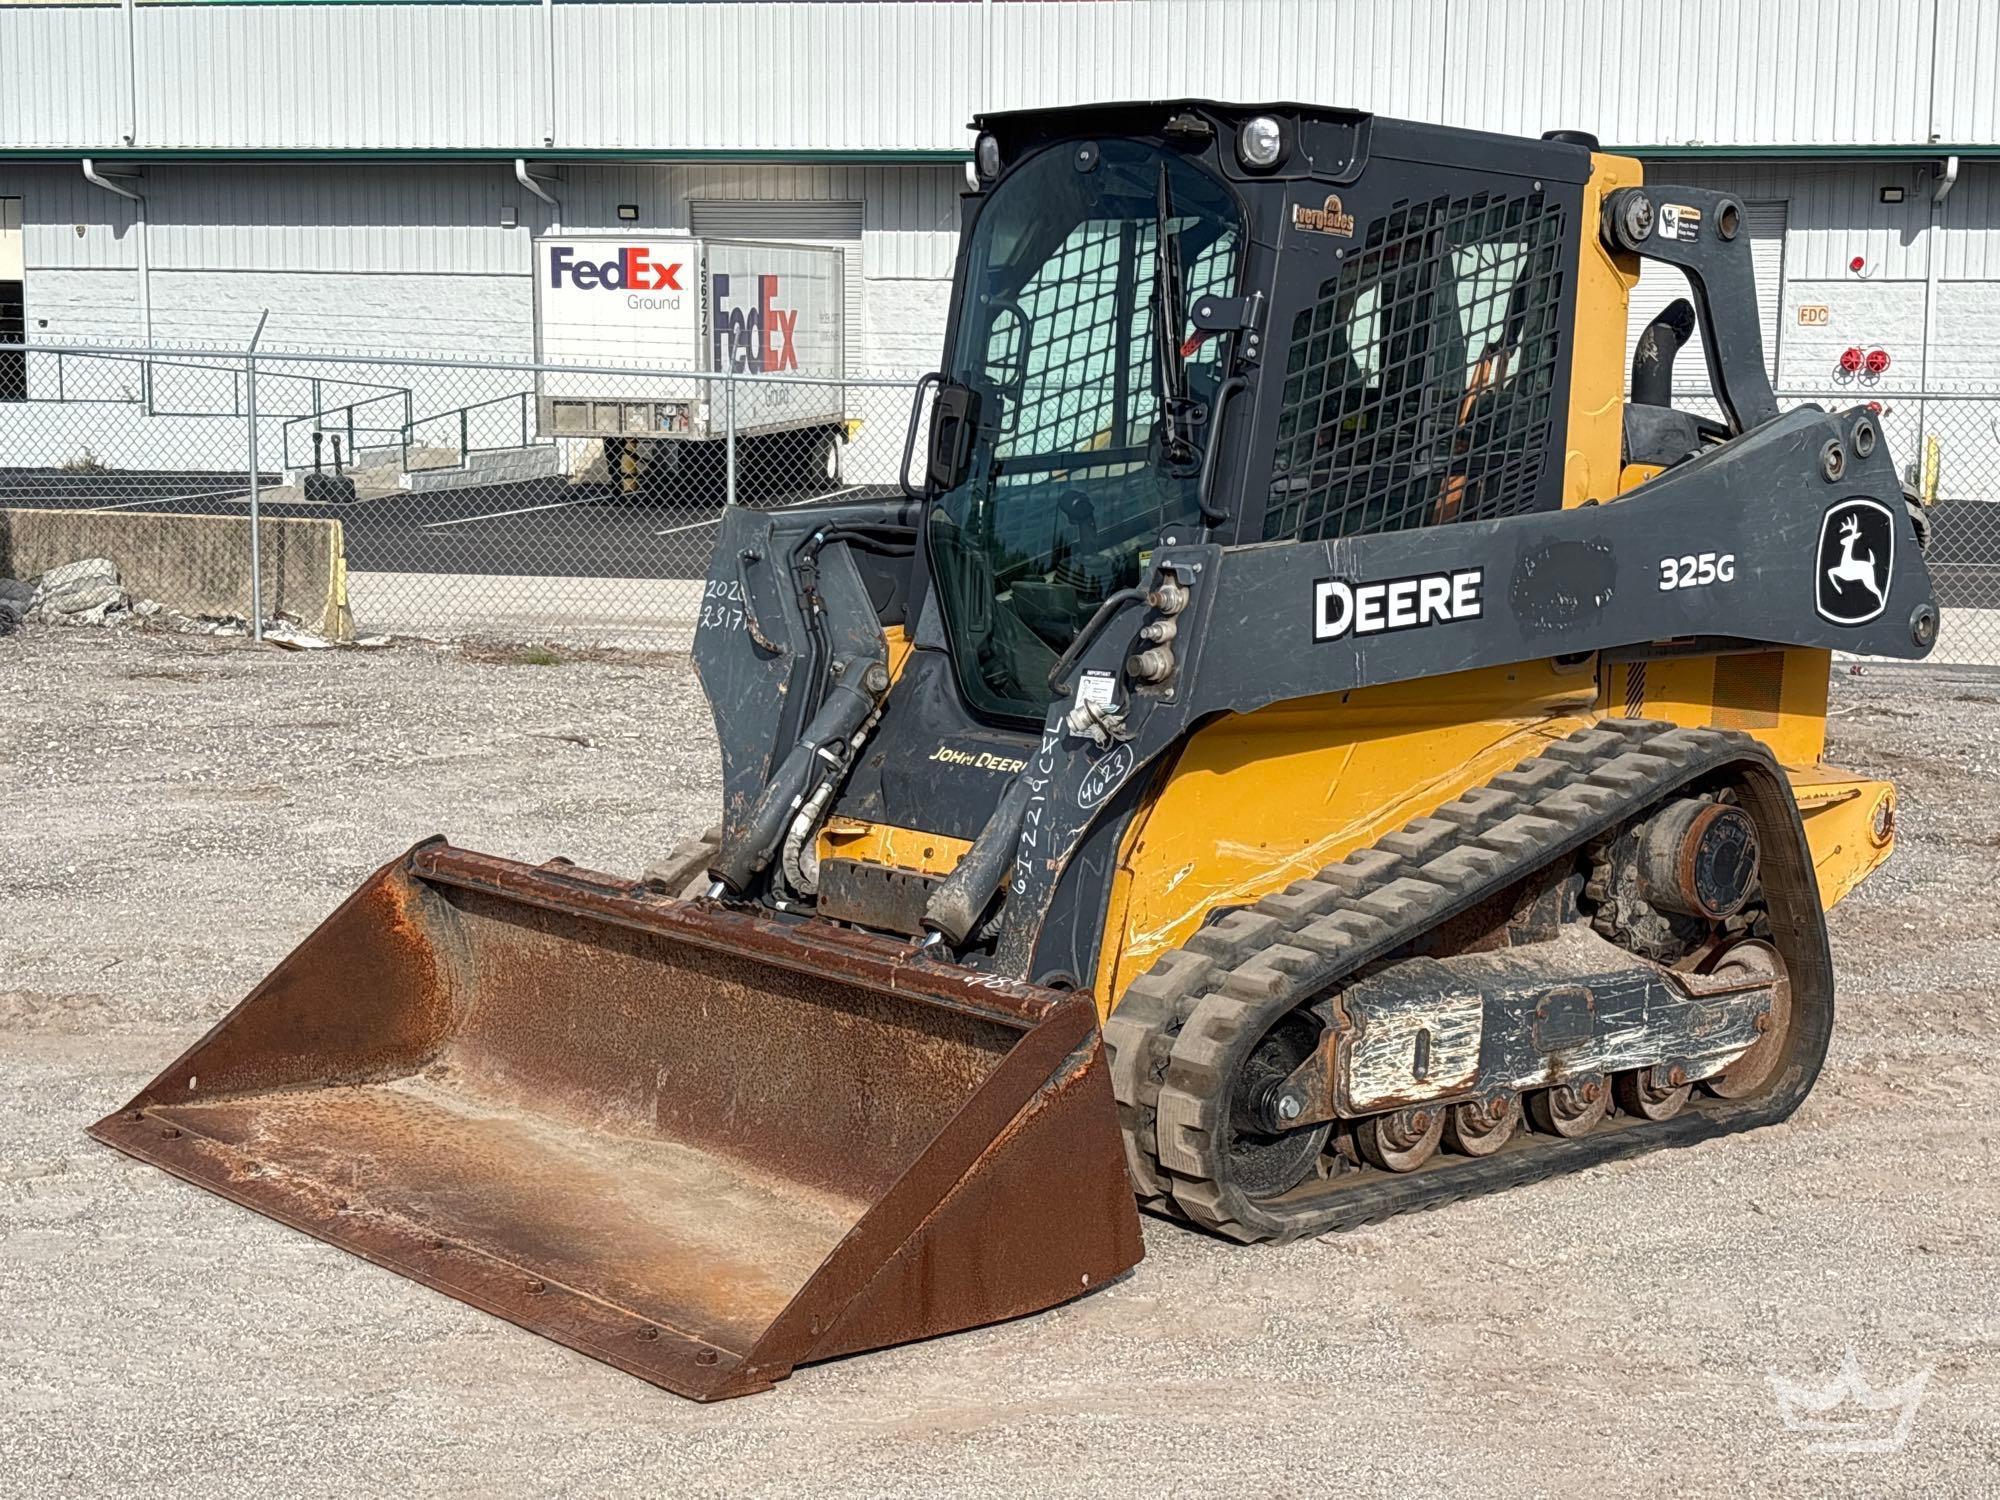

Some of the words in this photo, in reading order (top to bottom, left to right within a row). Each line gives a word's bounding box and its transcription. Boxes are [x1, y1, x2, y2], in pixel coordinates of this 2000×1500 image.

[551, 246, 684, 290] FedEx
[627, 294, 681, 310] Ground
[700, 257, 709, 336] 456272
[1800, 308, 1828, 322] FDC
[712, 273, 799, 374] FedEx
[1659, 552, 1735, 591] 325G
[1315, 571, 1482, 639] DEERE
[928, 746, 976, 766] JOHN
[1081, 754, 1124, 802] 4623
